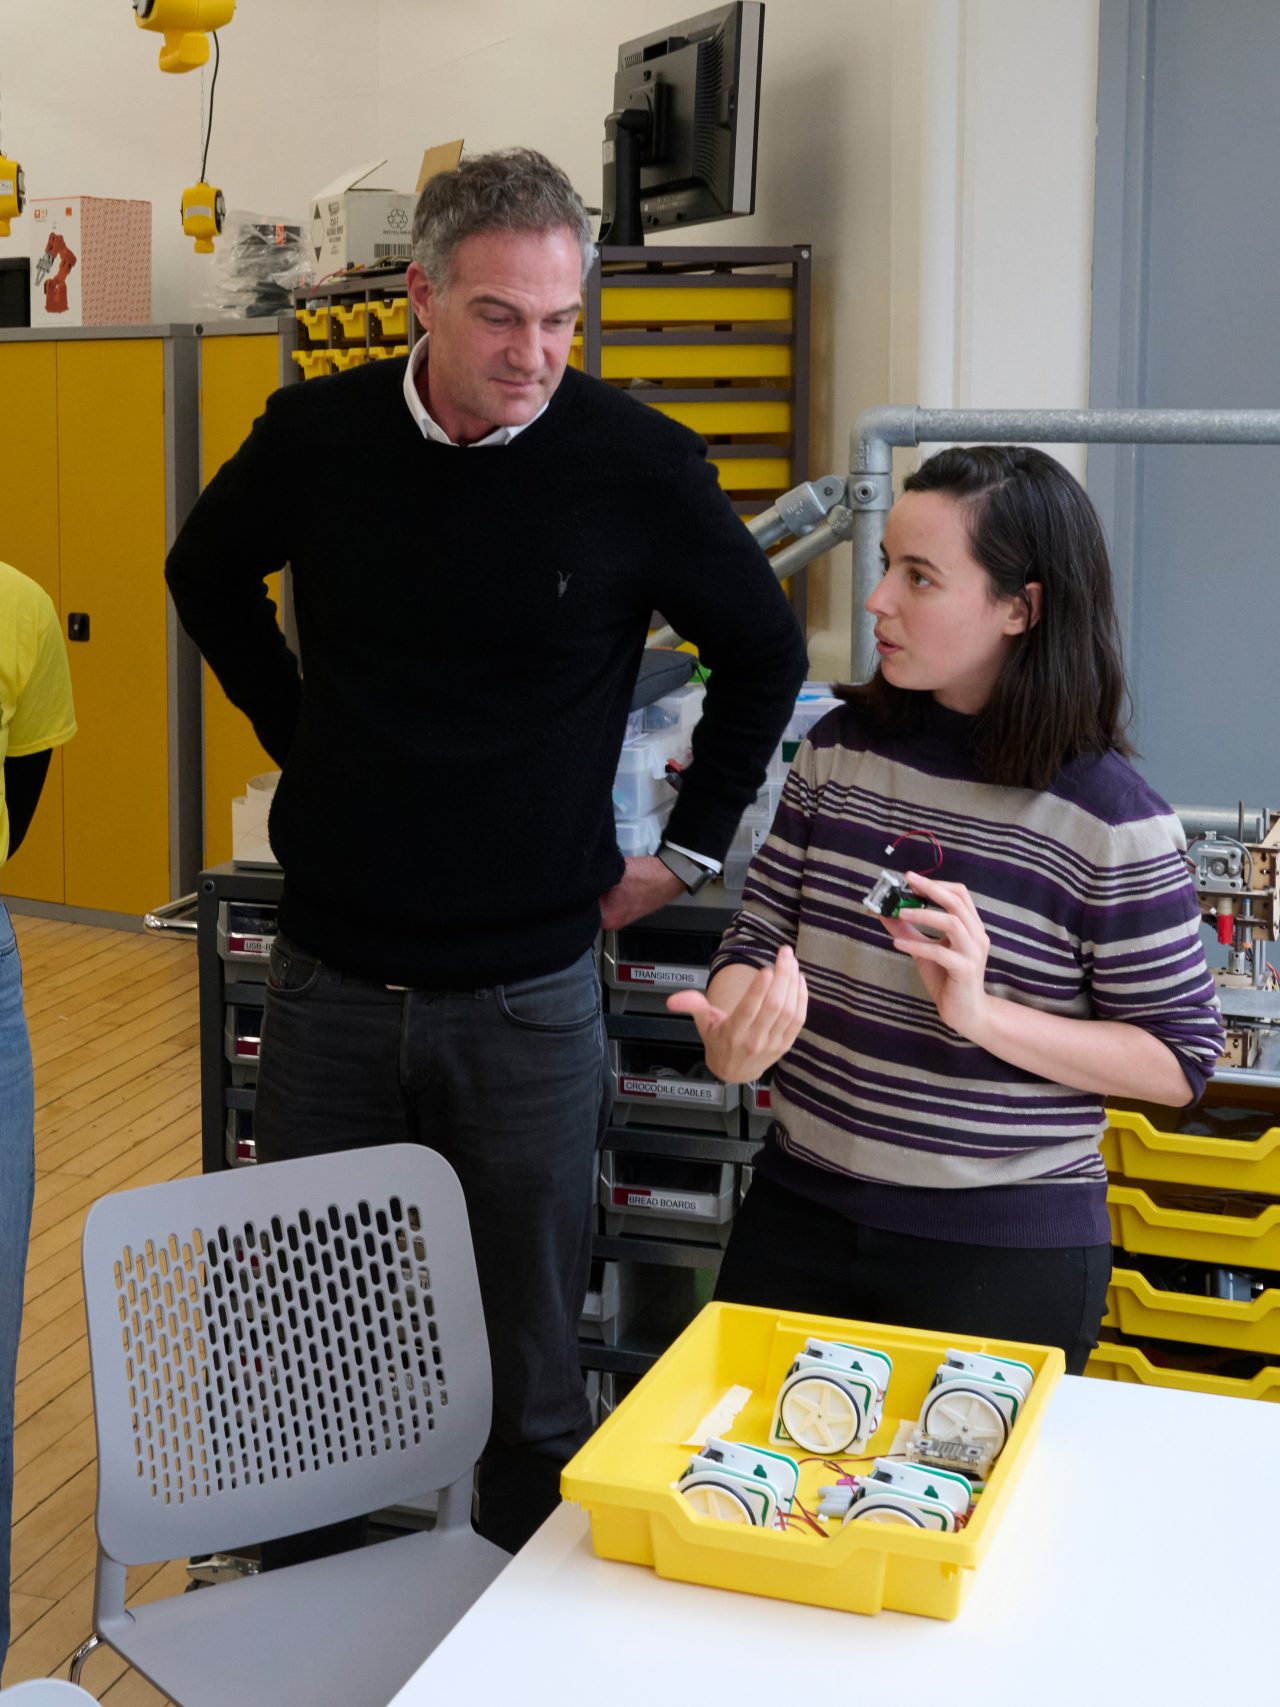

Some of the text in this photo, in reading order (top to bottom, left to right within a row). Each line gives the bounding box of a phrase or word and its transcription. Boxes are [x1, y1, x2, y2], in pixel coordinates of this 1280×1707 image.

[634, 969, 694, 982] TRANSISTORS
[626, 1081, 712, 1098] CROCODILE CABLES
[629, 1195, 696, 1210] BREAD BOARDS
